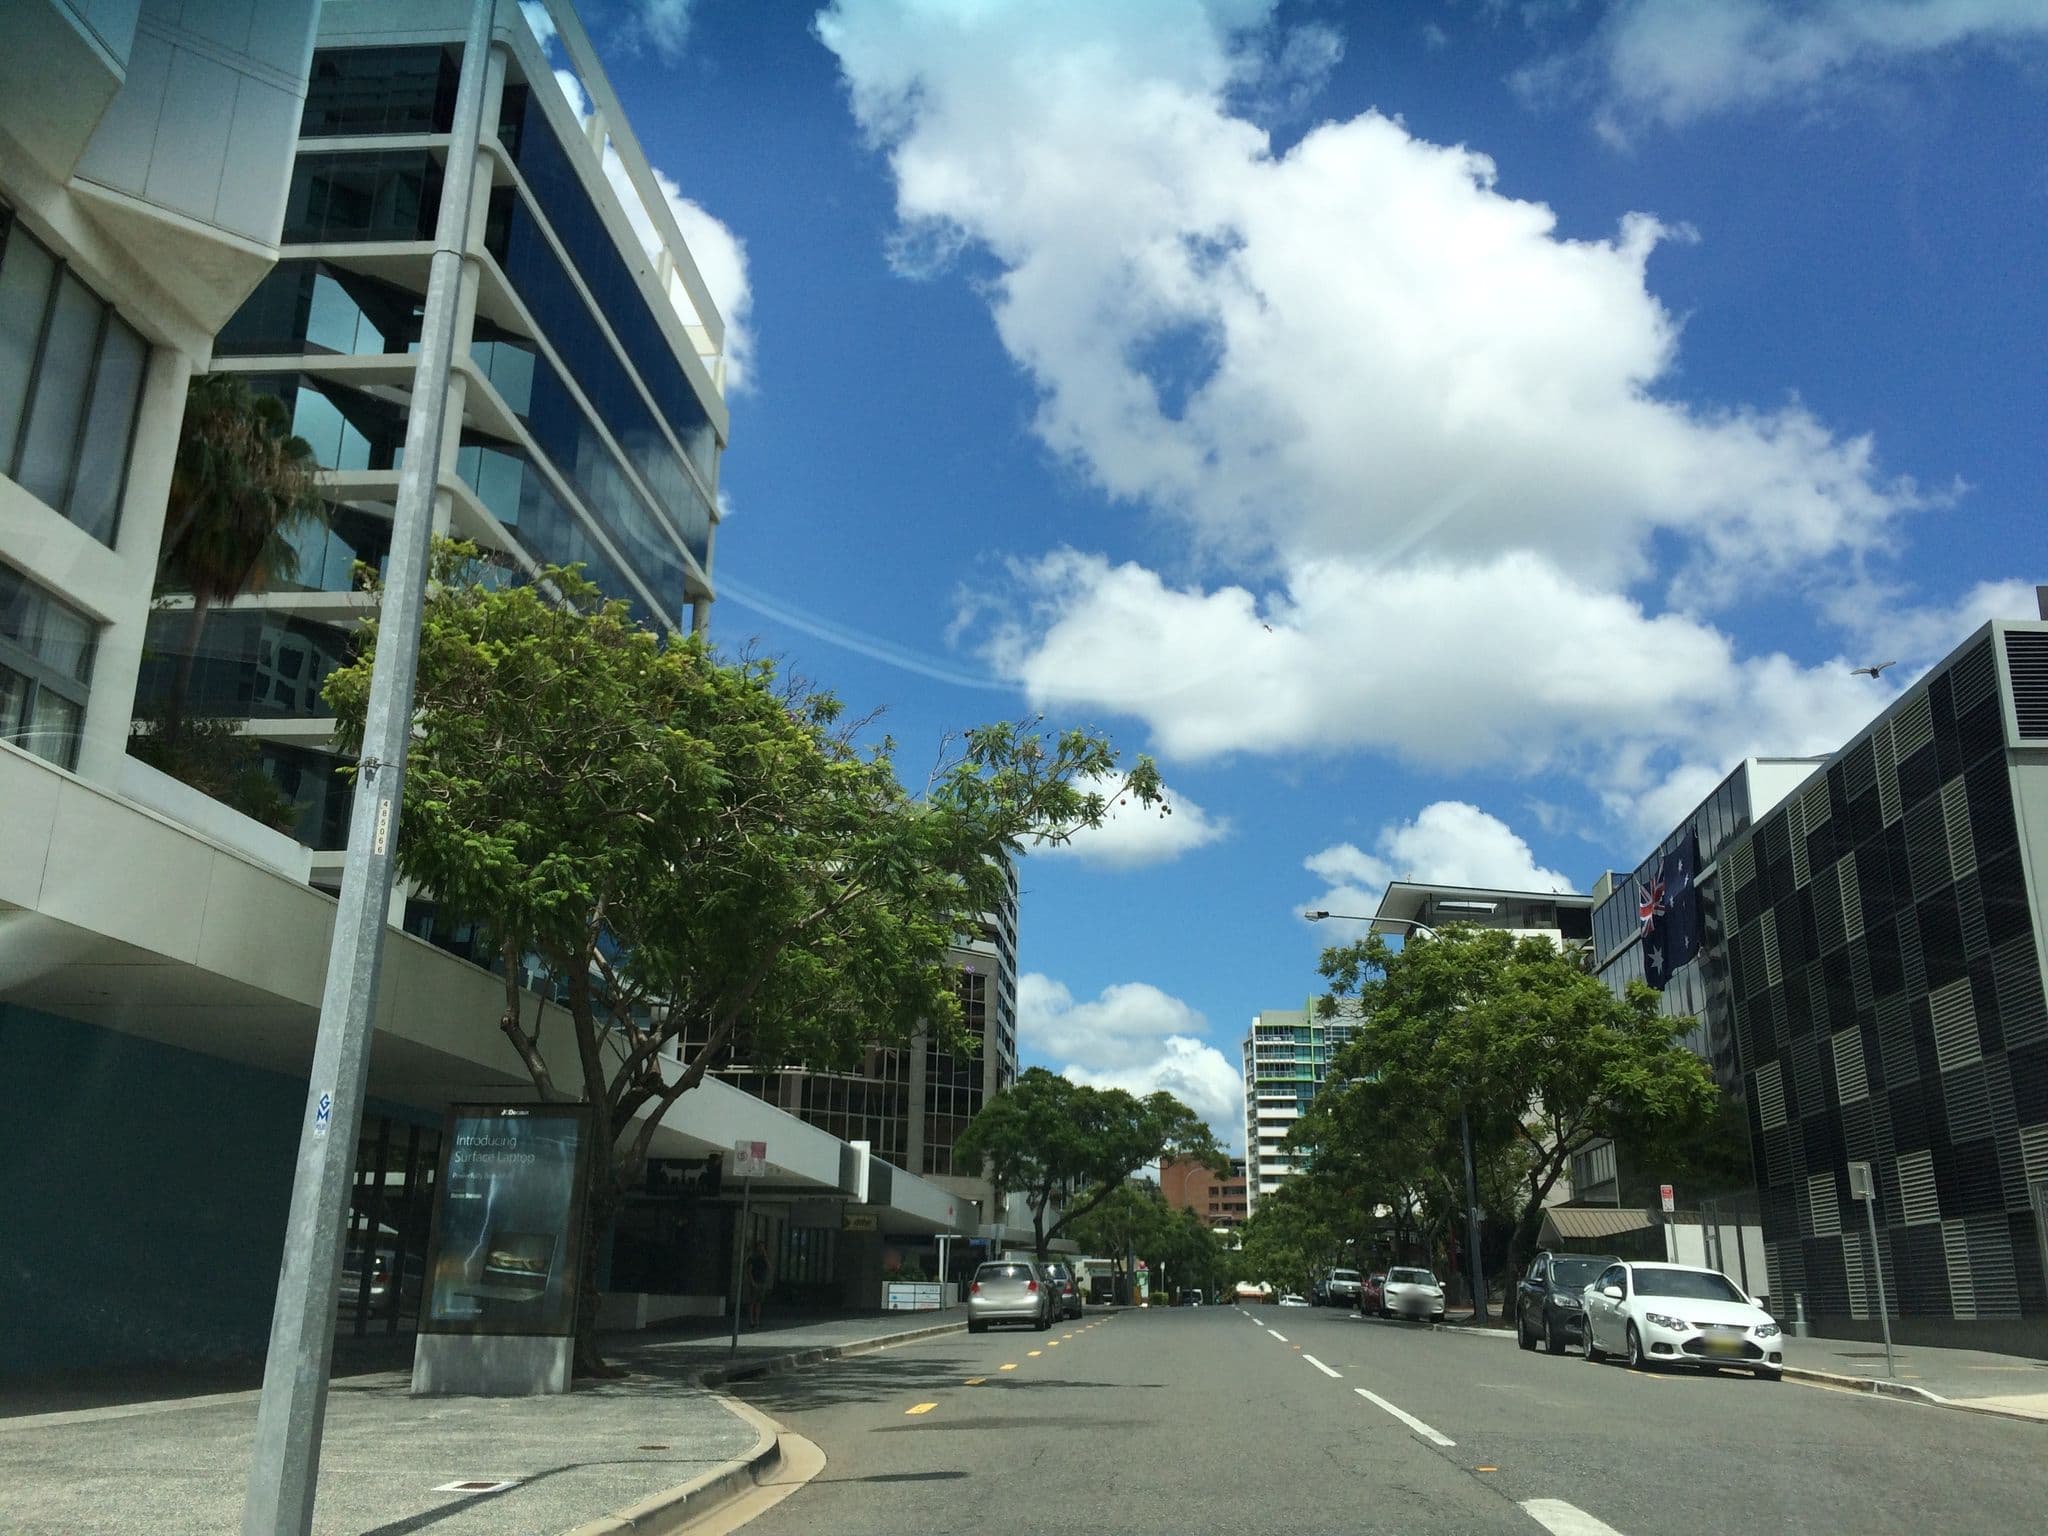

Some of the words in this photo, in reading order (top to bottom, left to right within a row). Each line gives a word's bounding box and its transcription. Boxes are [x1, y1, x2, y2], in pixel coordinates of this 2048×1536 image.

[377, 801, 388, 853] 485066
[456, 1134, 517, 1149] Introducing
[455, 1151, 496, 1163] Surface
[498, 1151, 536, 1166] Laptop
